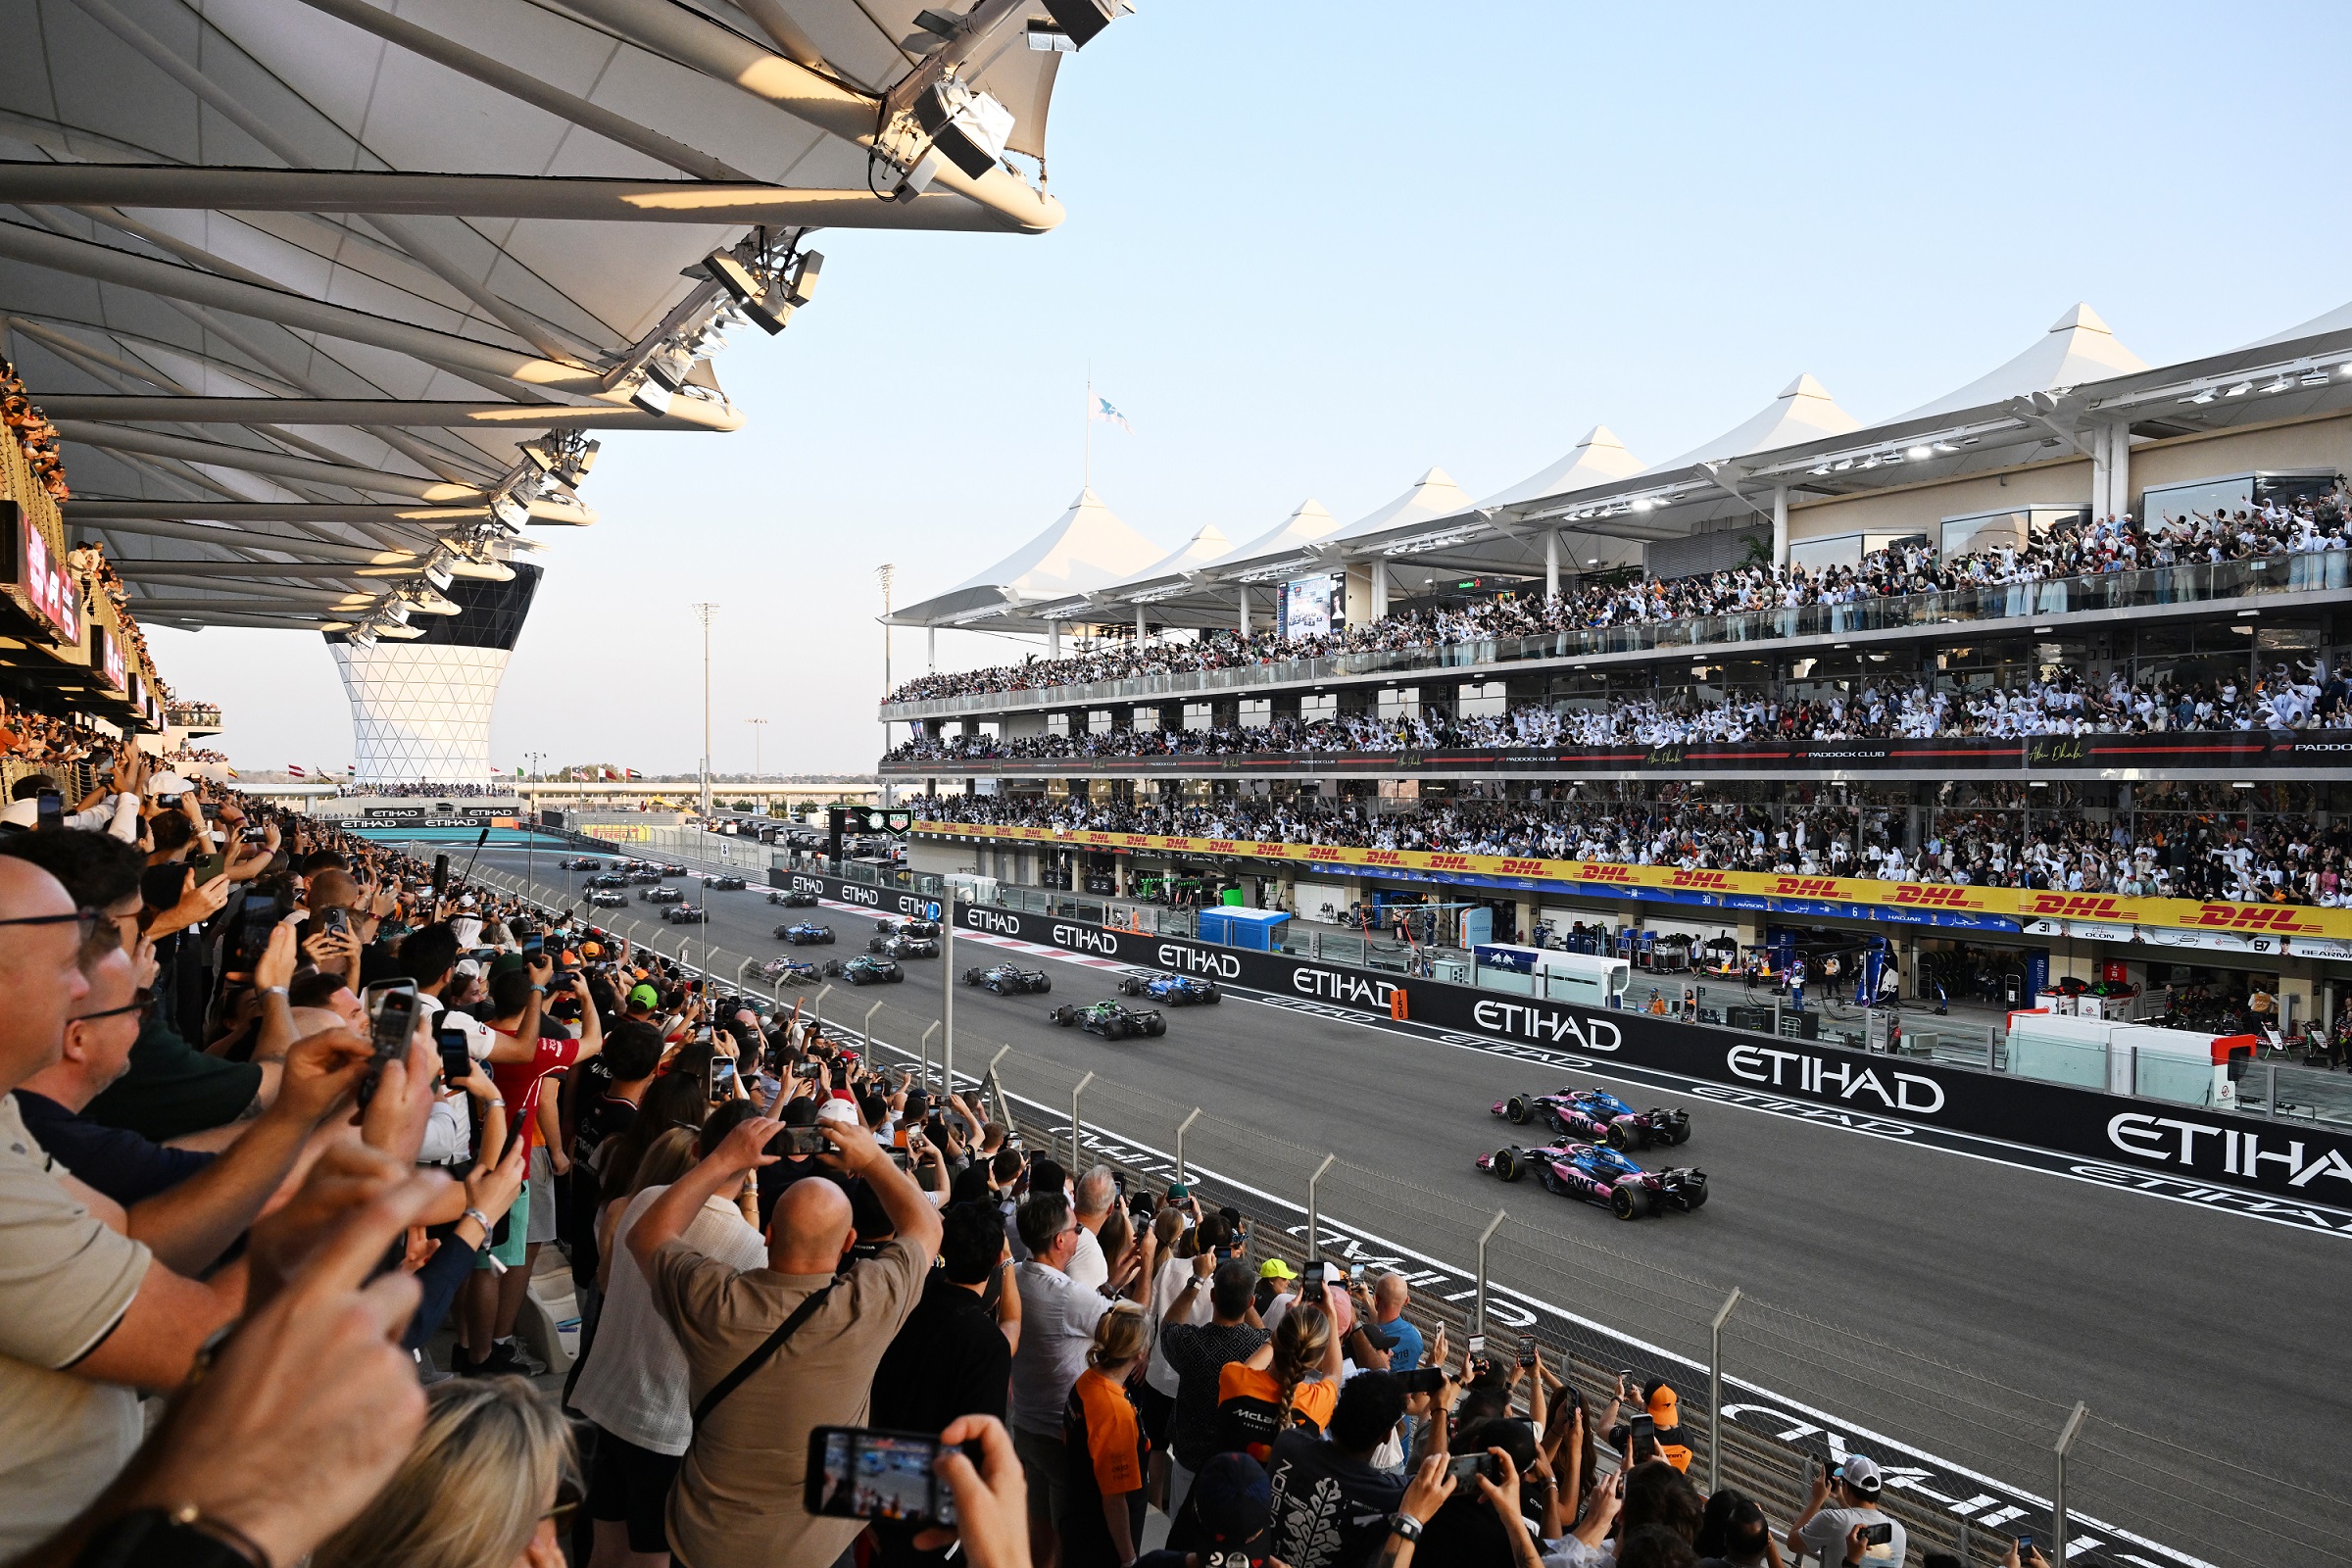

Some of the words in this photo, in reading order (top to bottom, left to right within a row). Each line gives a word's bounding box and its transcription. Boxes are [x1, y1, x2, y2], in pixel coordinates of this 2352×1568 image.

[1647, 750, 1660, 764] Abu
[1662, 750, 1682, 764] Dhabi
[2029, 745, 2049, 761] Abu
[2051, 742, 2084, 761] Dhabi
[592, 828, 639, 841] PIRELI
[1090, 833, 1109, 843] DHL
[1127, 836, 1148, 846] DHL
[1166, 838, 1189, 849] DHL
[1209, 841, 1235, 853] DHL
[1257, 844, 1285, 856] DHL
[1309, 848, 1340, 860] DHL
[1366, 851, 1401, 865] DHL
[1430, 856, 1470, 870] DHL
[1501, 860, 1545, 876] DHL
[1581, 865, 1631, 882] DHL
[1673, 871, 1728, 889] DHL
[792, 876, 824, 894] ETIHAD
[1776, 878, 1840, 899] DHL
[842, 885, 878, 905] ETIHAD
[1702, 895, 1711, 904] 30
[1893, 885, 1970, 907] DHL
[1852, 907, 1858, 917] 6
[2034, 894, 2123, 919] DHL
[967, 908, 1020, 934] ETIHAD
[1888, 914, 1921, 923] HADJAR
[2197, 905, 2303, 931] DHL
[2039, 922, 2050, 932] 31
[1053, 925, 1118, 955] ETIHAD
[2254, 940, 2270, 952] 87
[1158, 944, 1240, 979] ETIHAD
[1293, 968, 1399, 1009] ETIHAD
[1262, 997, 1375, 1023] ETIHAD
[1473, 1000, 1621, 1052] ETIHAD
[1440, 1035, 1593, 1069] ETIHAD
[1727, 1044, 1945, 1114] ETIHAD
[1691, 1087, 1914, 1135] ETIHAD
[1570, 1116, 1595, 1130] BWT
[1568, 1174, 1598, 1192] BWT
[2070, 1166, 2352, 1231] ETIHA
[1233, 1408, 1276, 1424] McLa
